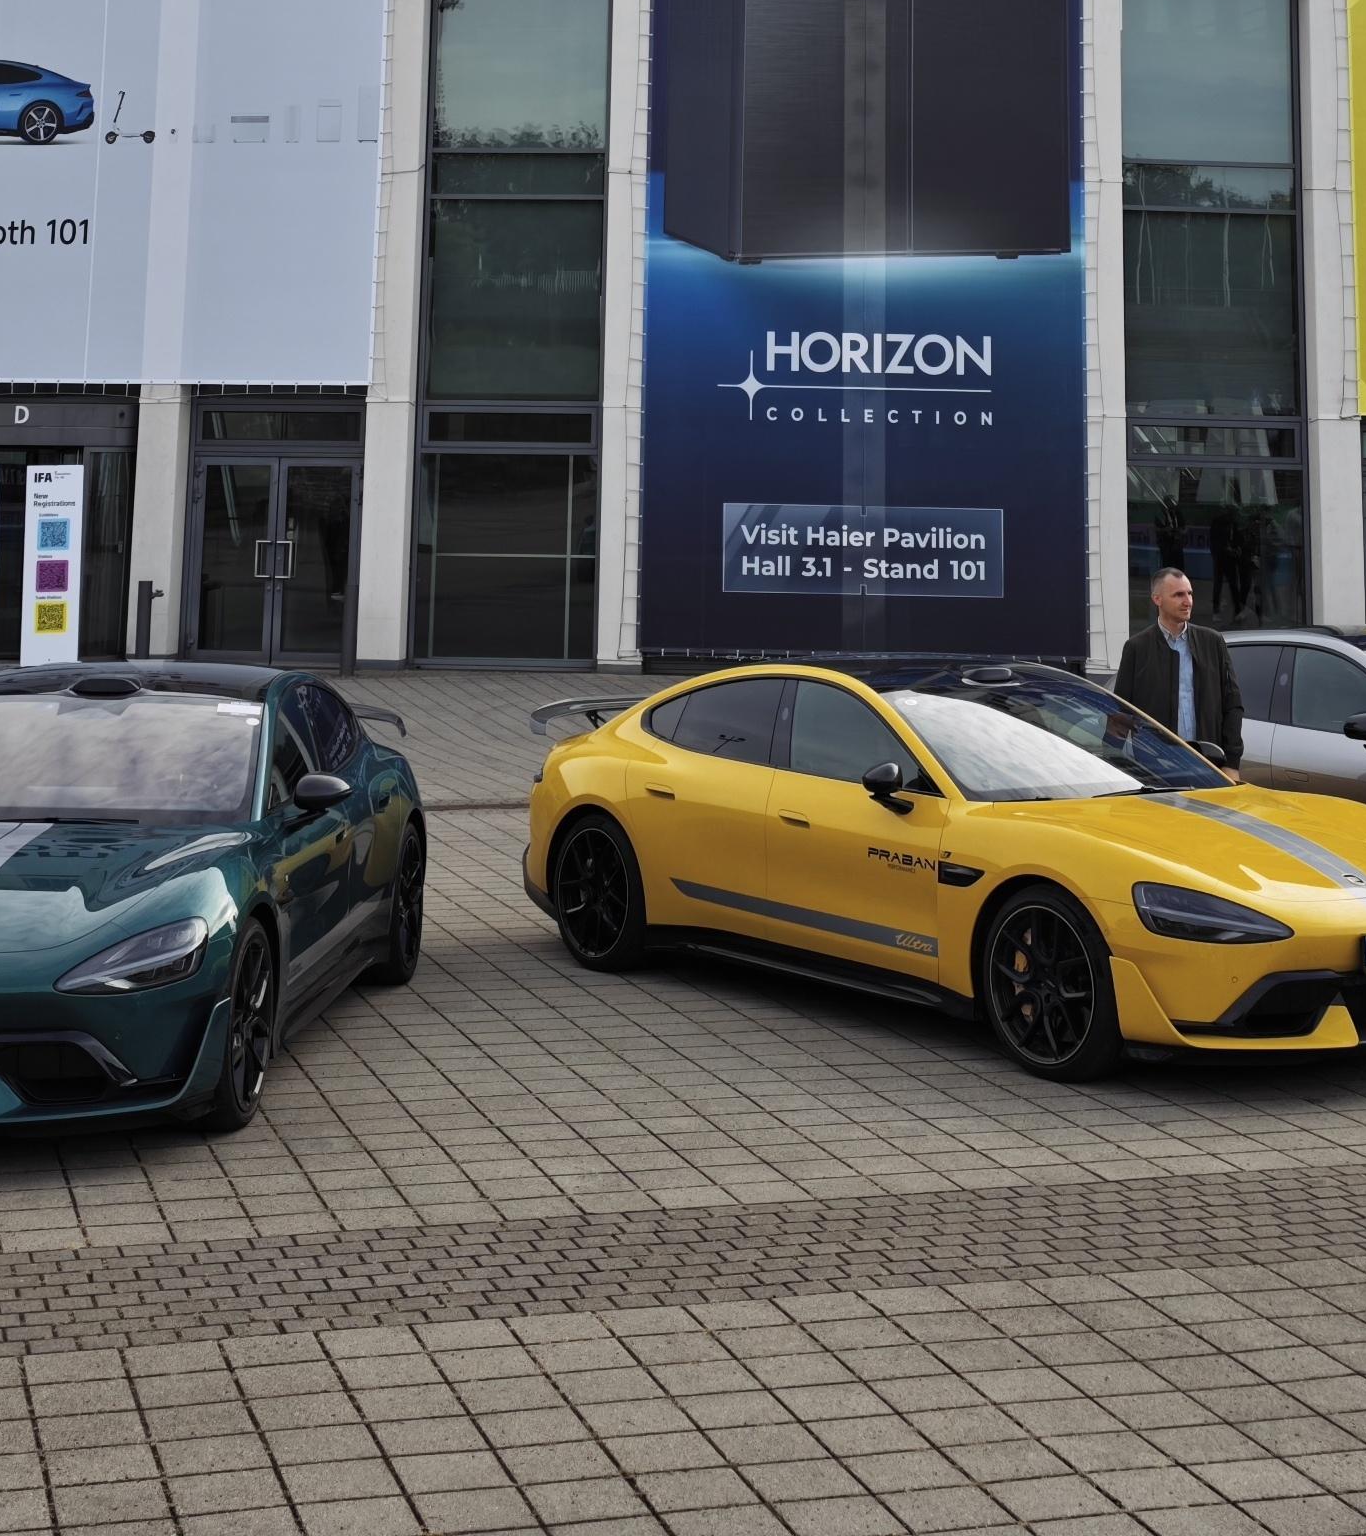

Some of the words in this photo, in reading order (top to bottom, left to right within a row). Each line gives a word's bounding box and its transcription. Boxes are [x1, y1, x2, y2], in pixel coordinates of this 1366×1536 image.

[46, 218, 91, 244] 101
[766, 330, 992, 376] HORIZON
[14, 405, 30, 424] D
[766, 406, 993, 426] COLLECTION
[34, 472, 52, 483] IFA
[33, 500, 75, 508] Registrations
[741, 524, 798, 546] Visit
[806, 525, 875, 547] Haier
[883, 527, 986, 550] Pavilion
[742, 555, 790, 577] Hall
[801, 556, 832, 578] 3.1
[863, 558, 939, 580] Stand
[951, 560, 986, 581] 101
[867, 847, 936, 871] PRABAN
[895, 932, 933, 953] Ultra
